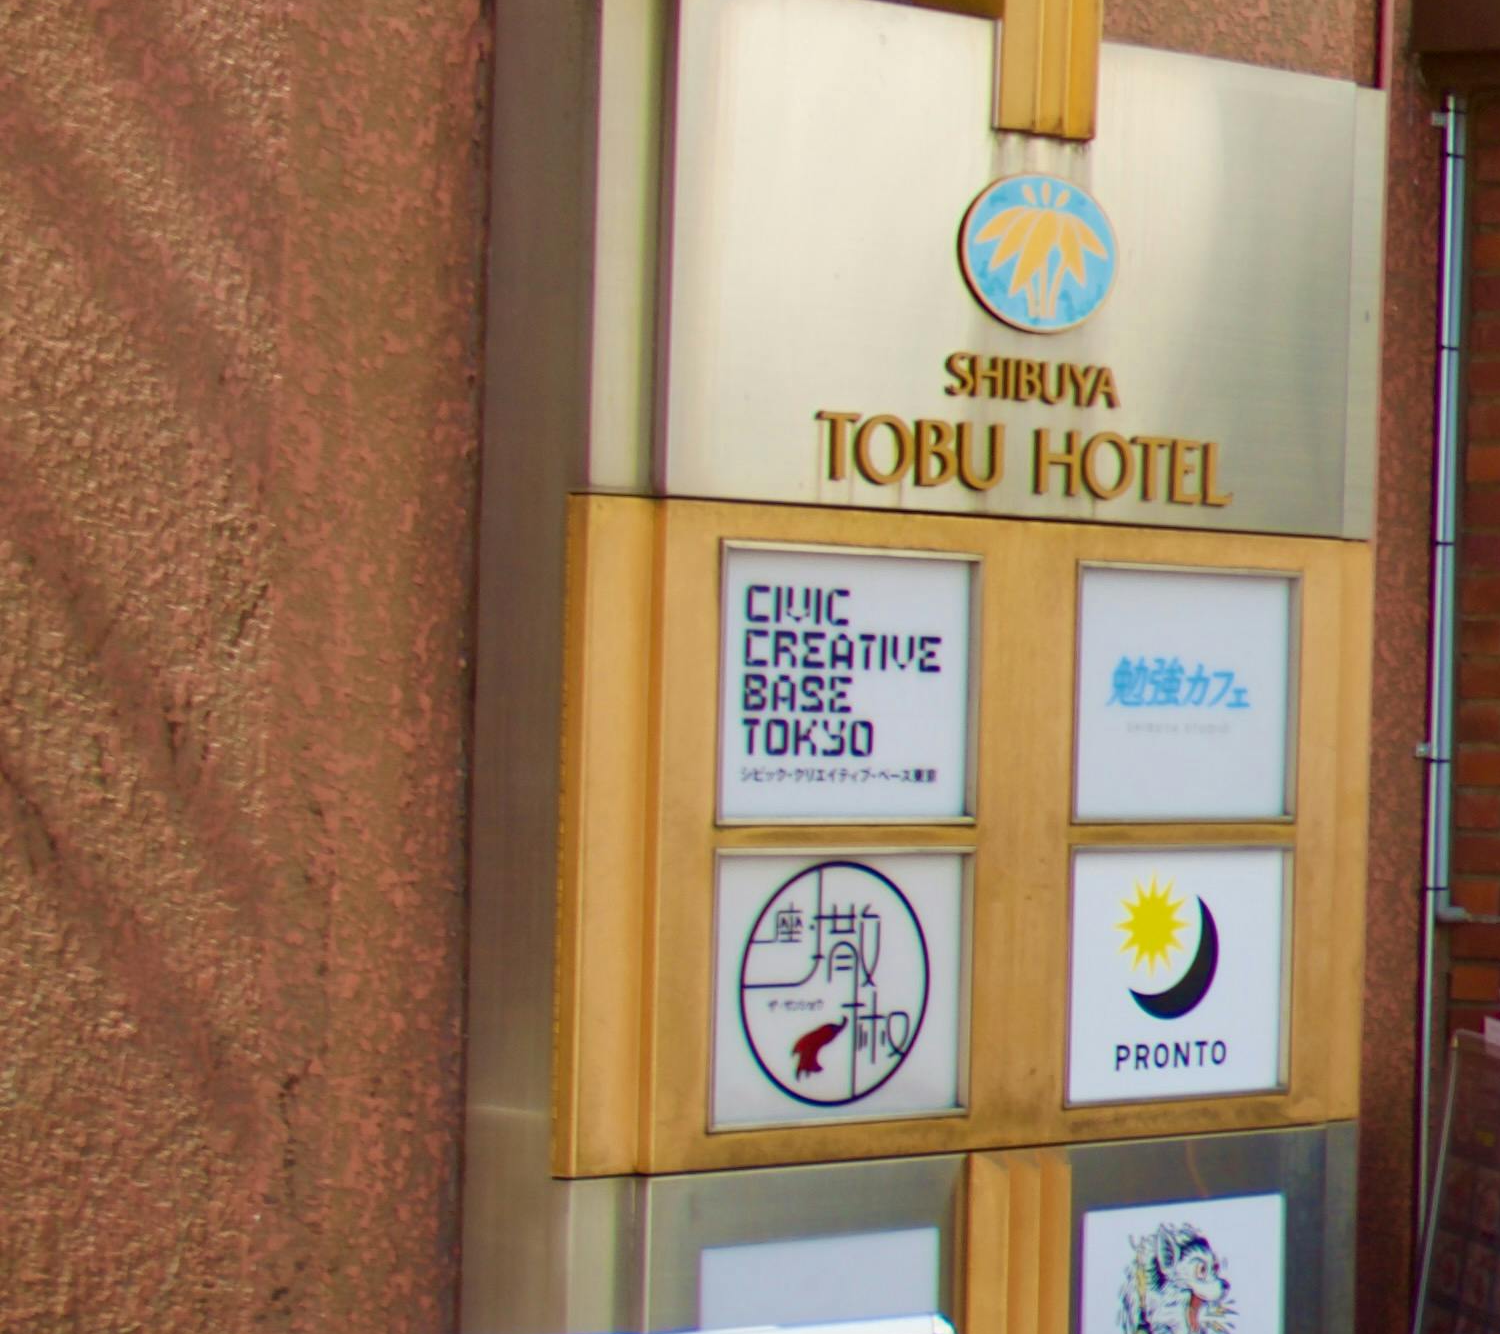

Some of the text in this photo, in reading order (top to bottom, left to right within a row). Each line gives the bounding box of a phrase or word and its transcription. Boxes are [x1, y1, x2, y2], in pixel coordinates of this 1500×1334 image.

[944, 351, 1121, 409] SHIBUYA
[815, 410, 1234, 508] TOBU HOTEL
[745, 585, 851, 627] CIVIC
[744, 629, 942, 673] CREATIVE
[743, 673, 853, 714] BASE
[1106, 656, 1251, 708] 勉強カフェ
[742, 718, 874, 757] TOKYO
[1115, 1040, 1227, 1071] PRONTO
